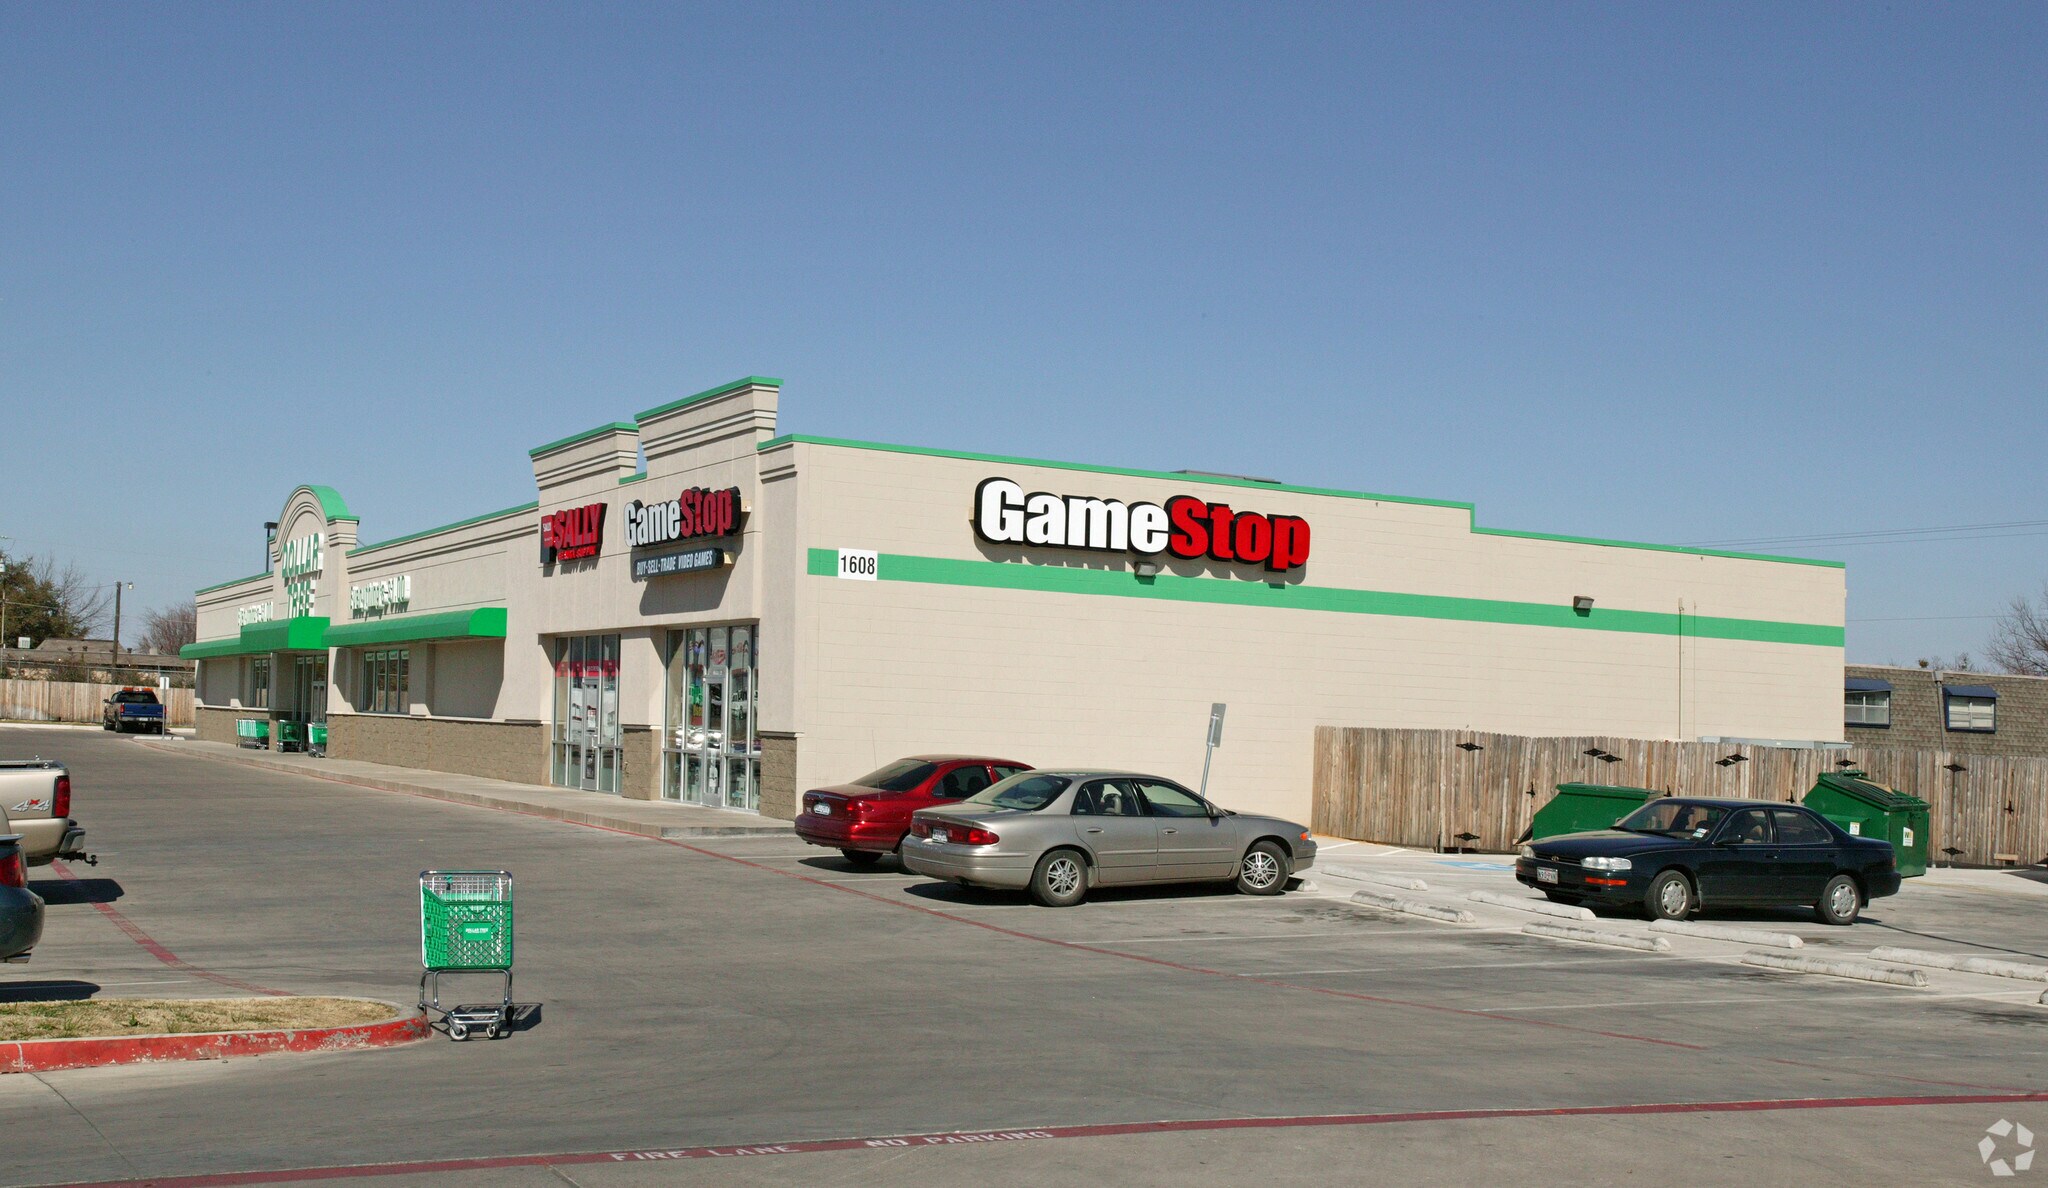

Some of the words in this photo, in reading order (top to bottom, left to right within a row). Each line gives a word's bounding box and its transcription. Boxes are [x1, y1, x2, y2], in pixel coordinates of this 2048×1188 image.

[553, 503, 603, 550] SALLY
[624, 488, 734, 548] GameStop
[980, 477, 1311, 570] GameStop
[282, 533, 324, 578] DOLLAR
[678, 553, 694, 570] VIDEO
[693, 550, 714, 567] GAMES
[840, 555, 876, 575] 1608
[287, 580, 317, 618] TREE
[610, 1150, 693, 1161] FIRE
[708, 1145, 801, 1157] LANE
[864, 1138, 909, 1148] NO
[920, 1131, 1054, 1145] PARKING
